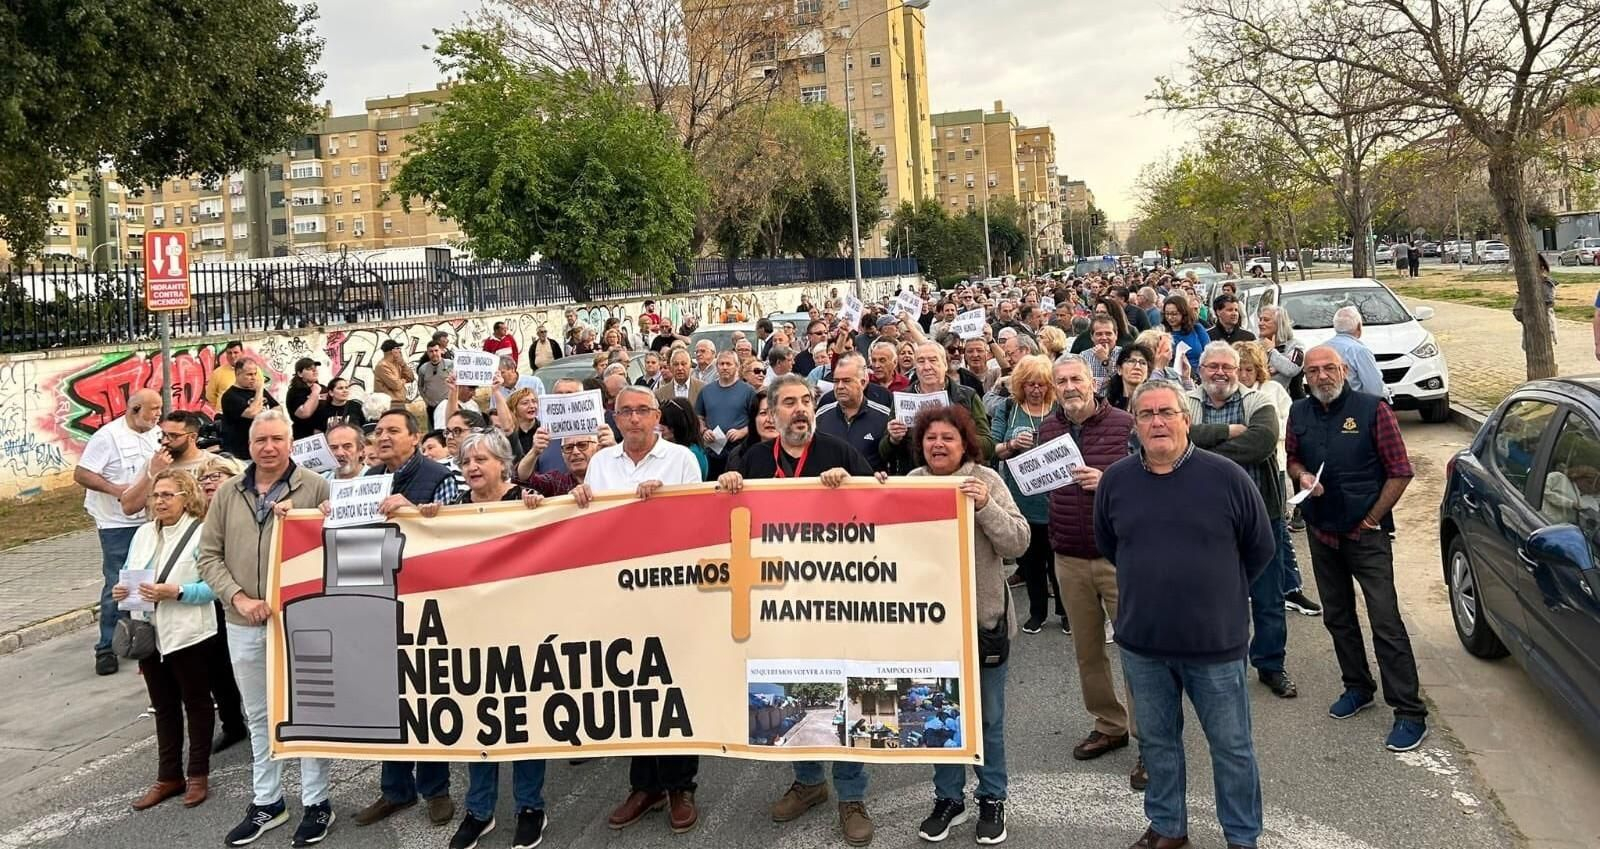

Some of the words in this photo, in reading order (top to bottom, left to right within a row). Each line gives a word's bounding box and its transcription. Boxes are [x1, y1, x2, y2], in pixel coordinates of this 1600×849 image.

[150, 283, 186, 291] HIDRANTE
[150, 298, 187, 306] INCENDIOS
[761, 516, 875, 544] INVERSIÓN
[618, 563, 730, 589] QUEREMOS
[760, 556, 898, 584] INNOVACIÓN
[397, 599, 448, 645] LA
[760, 599, 946, 624] MANTENIMIENTO
[397, 634, 673, 696] NEUMÁTICA
[877, 667, 913, 675] TAMPOCO
[399, 697, 463, 746] NO
[476, 696, 528, 745] SE
[543, 687, 694, 746] QUITA
